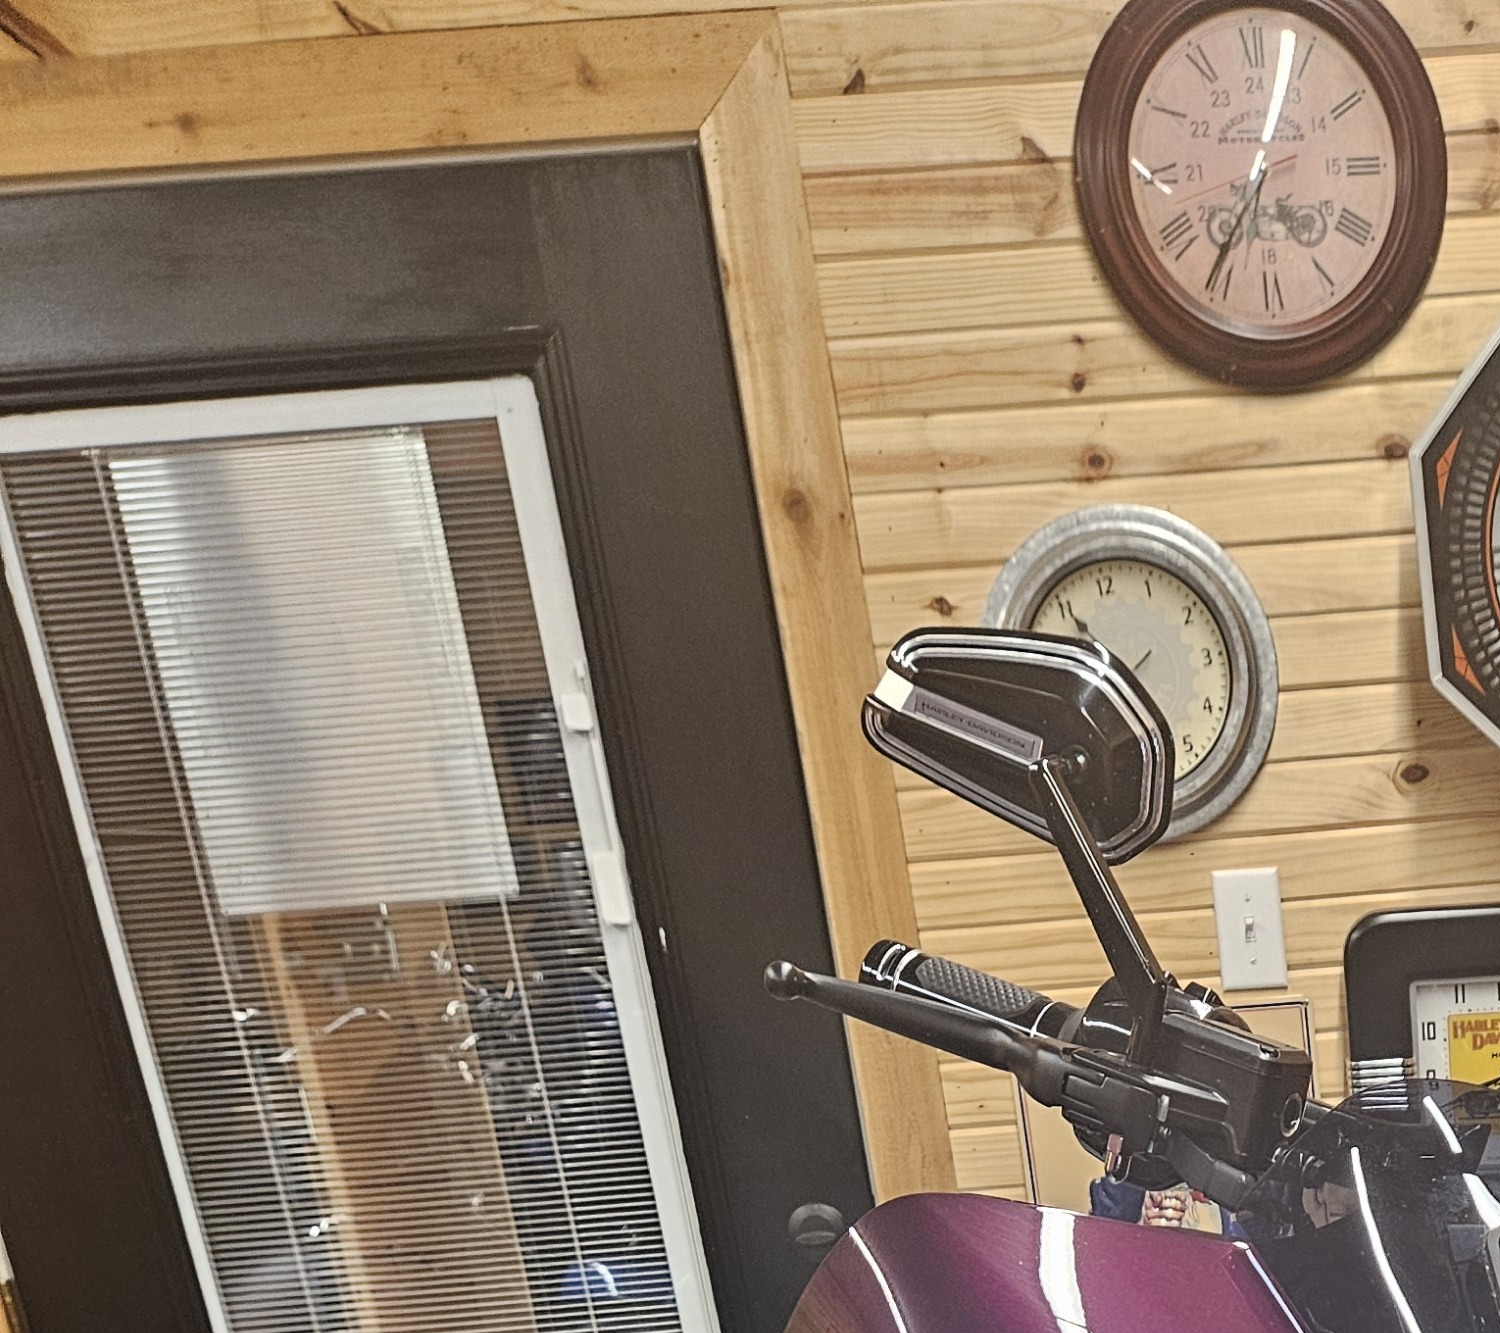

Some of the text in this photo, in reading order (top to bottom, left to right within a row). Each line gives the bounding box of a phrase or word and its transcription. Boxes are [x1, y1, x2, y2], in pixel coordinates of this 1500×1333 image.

[1244, 76, 1264, 94] 24
[1210, 89, 1231, 108] 23
[1190, 120, 1211, 138] 22
[1310, 115, 1326, 132] 14
[1185, 164, 1203, 182] 21
[1325, 157, 1341, 175] 15
[1261, 249, 1276, 265] 18
[1096, 575, 1116, 599] 12
[1144, 579, 1153, 598] 1
[1056, 593, 1074, 620] 11
[1182, 605, 1195, 625] 2
[1202, 647, 1214, 667] 3
[1202, 696, 1215, 713] 4
[1182, 733, 1195, 754] 5
[1454, 983, 1466, 1004] 11
[1421, 1021, 1436, 1041] 10
